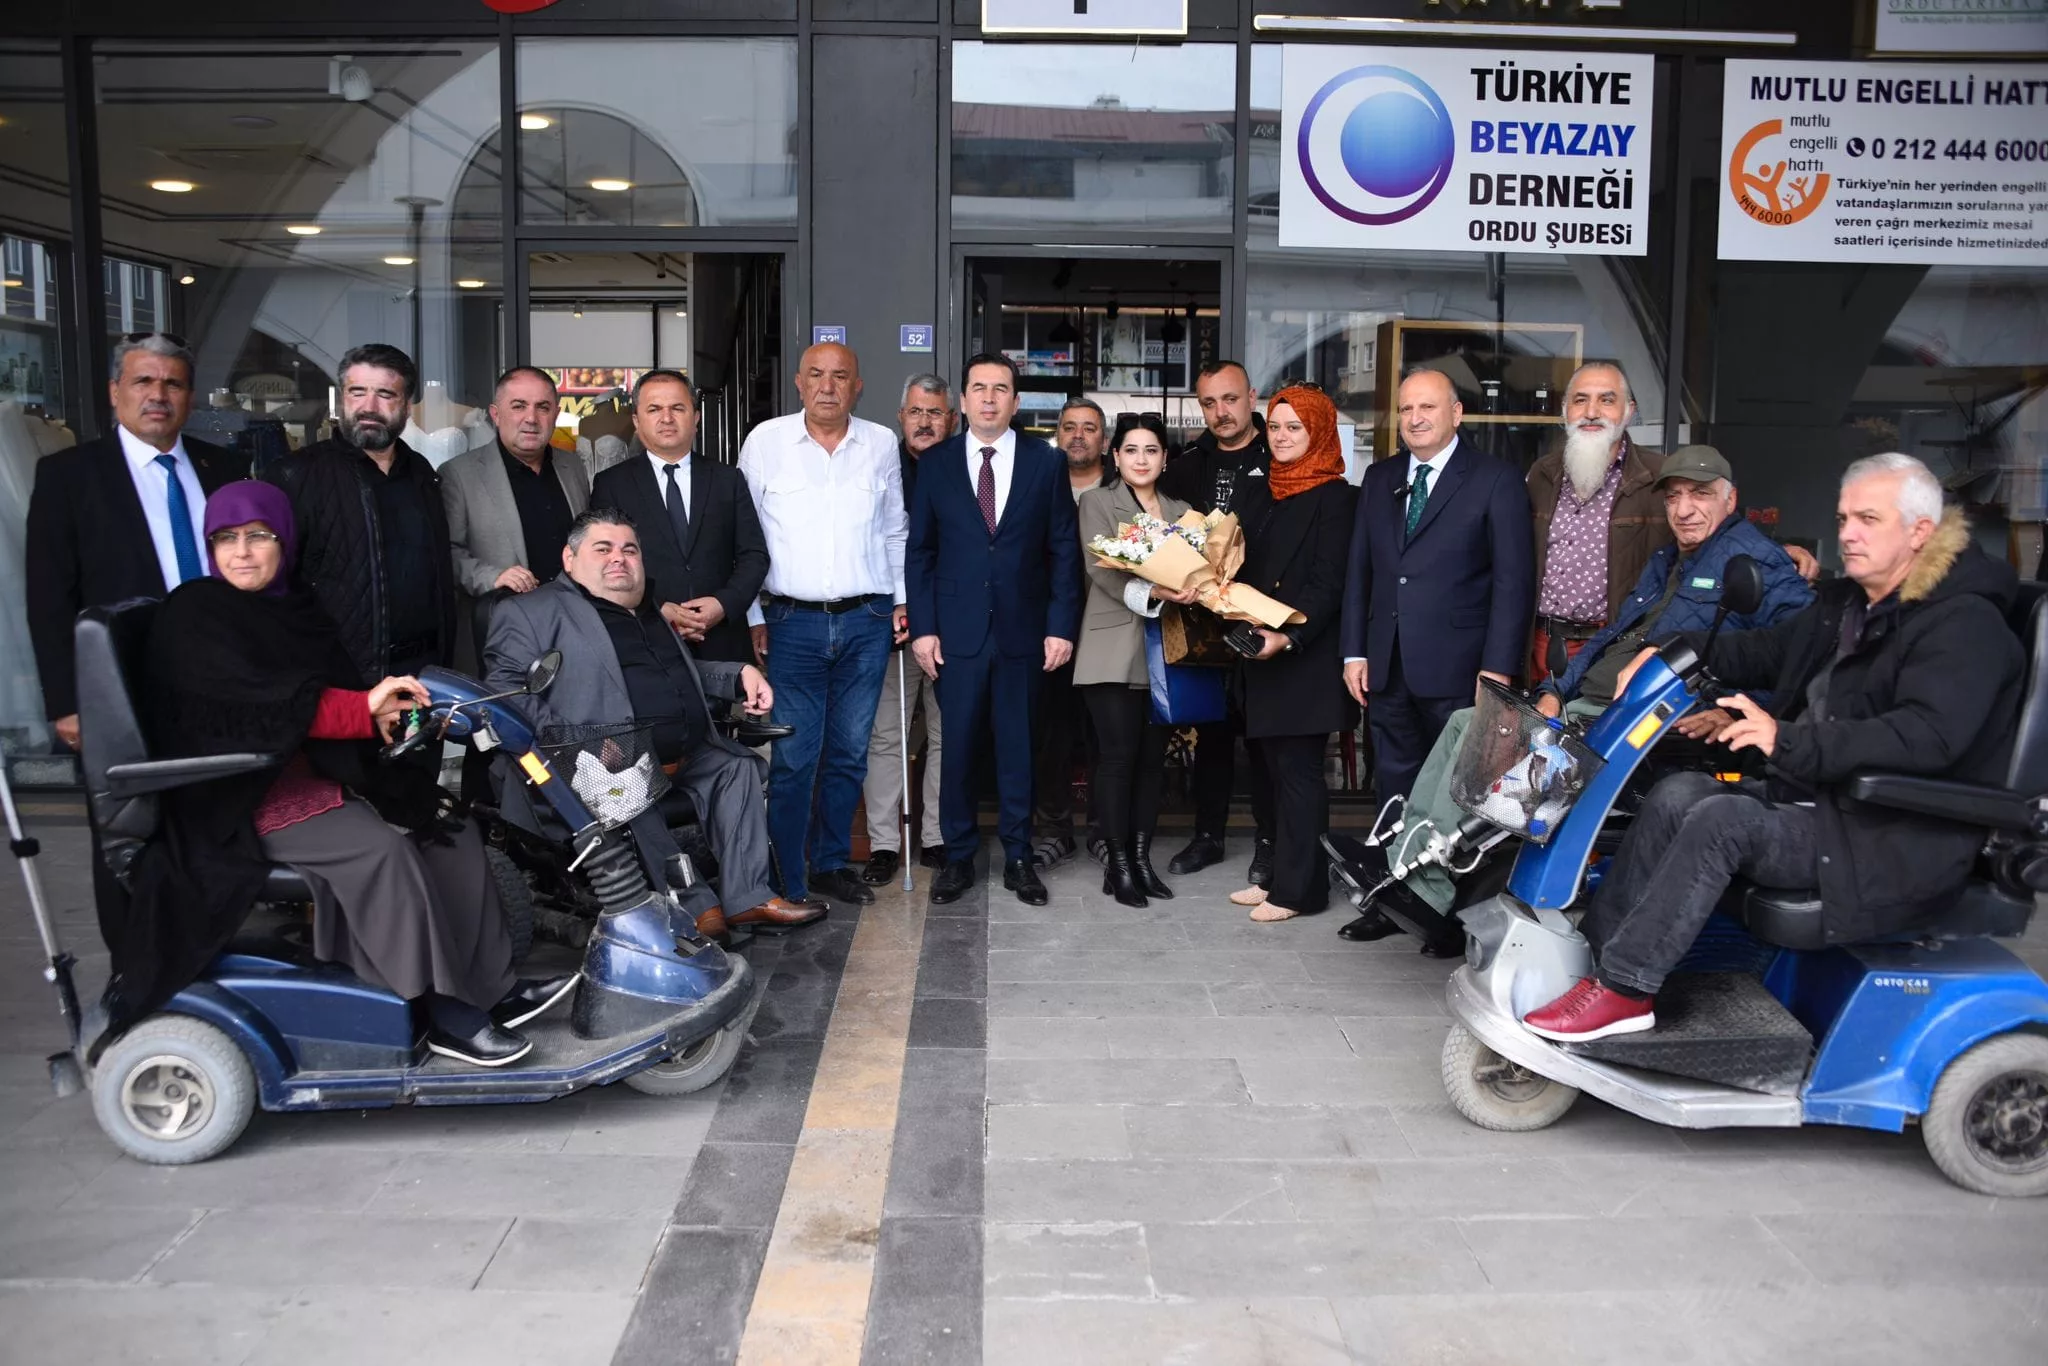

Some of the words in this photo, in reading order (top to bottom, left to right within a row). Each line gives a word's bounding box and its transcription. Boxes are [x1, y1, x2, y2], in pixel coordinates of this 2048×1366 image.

[1470, 60, 1632, 105] TÜRKİYE
[1750, 76, 1846, 103] MUTLU
[1856, 73, 1974, 105] ENGELLİ
[1790, 114, 1830, 127] mutlu
[1470, 120, 1636, 157] BEYAZAY
[1789, 136, 1838, 153] engelli
[1872, 138, 1885, 159] 0
[1893, 138, 1936, 160] 212
[1943, 139, 1987, 161] 444
[1995, 140, 2048, 162] 6000
[1788, 158, 1824, 171] hattı
[1469, 168, 1633, 210] DERNEĞİ
[1915, 180, 1936, 191] her
[1940, 181, 1998, 193] yerinden
[2002, 182, 2047, 195] engelli
[1836, 198, 1953, 211] vatandaşlarımızın
[1957, 201, 2024, 211] sorularına
[1757, 211, 1793, 225] 6000
[1835, 217, 1871, 227] veren
[1876, 217, 1909, 230] çağrı
[1913, 218, 1989, 230] merkezimiz
[1993, 219, 2033, 230] mesai
[1468, 220, 1537, 242] ORDU
[1834, 235, 1884, 246] saatleri
[1888, 236, 1953, 249] içerisinde
